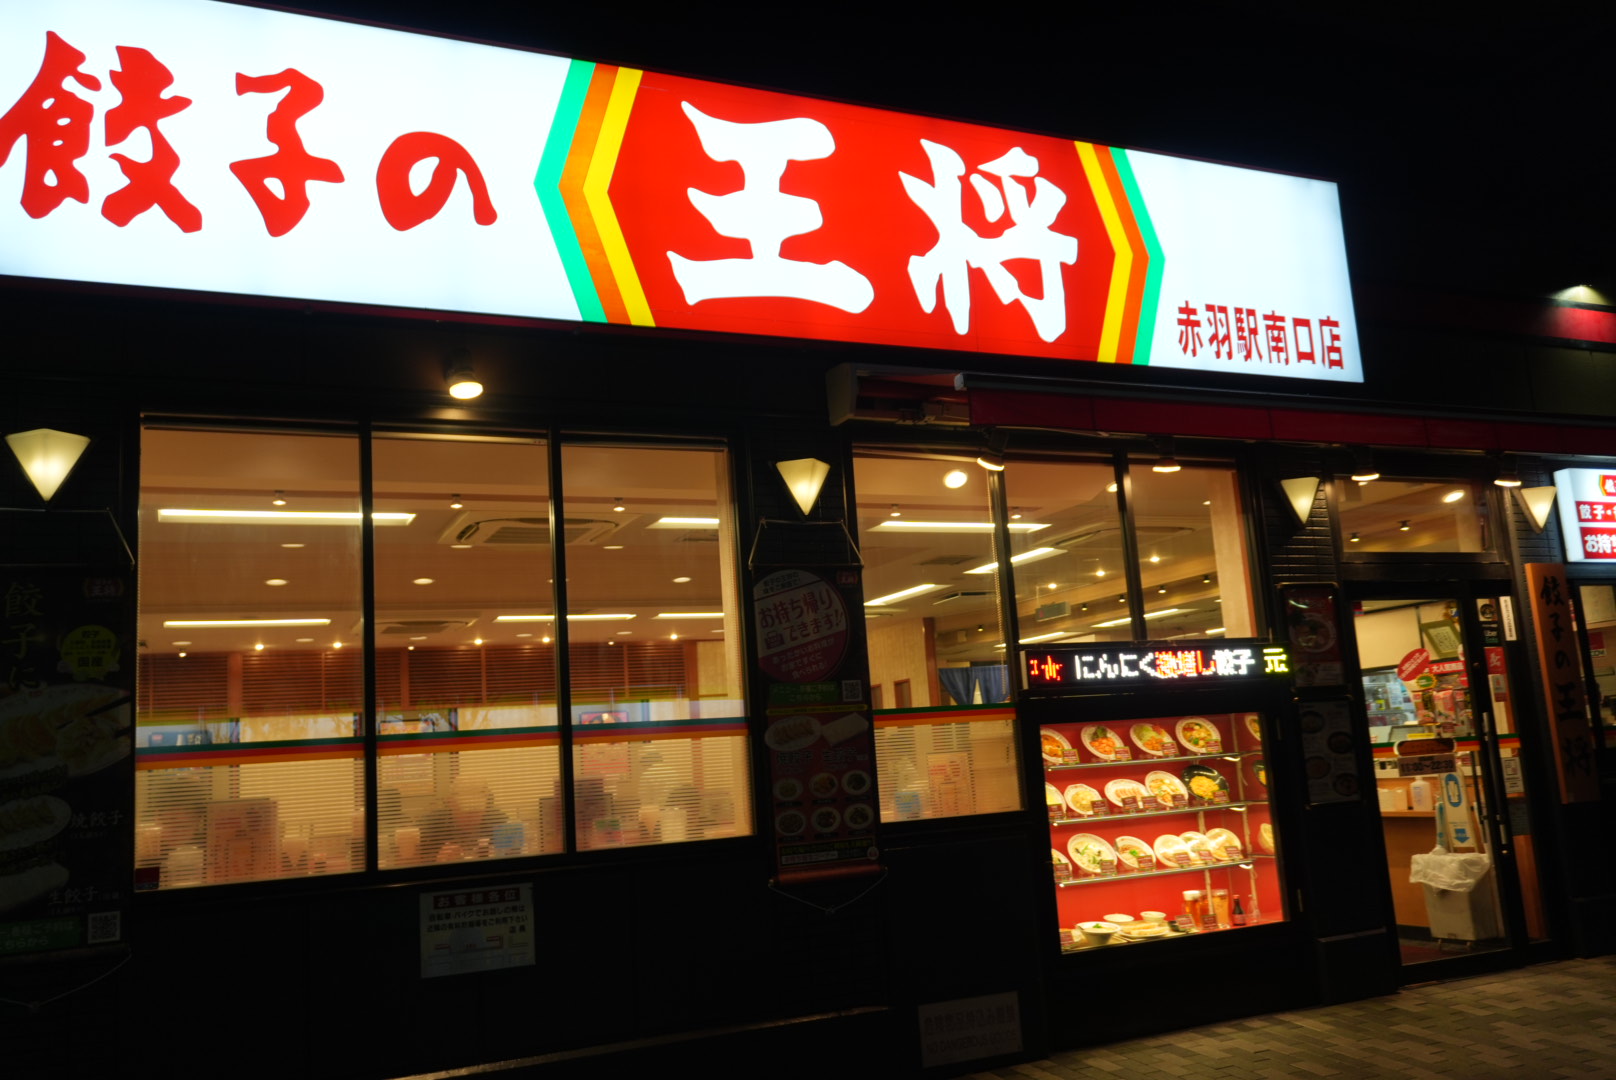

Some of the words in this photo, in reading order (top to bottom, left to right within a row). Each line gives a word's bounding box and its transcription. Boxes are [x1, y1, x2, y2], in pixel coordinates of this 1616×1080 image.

[0, 30, 498, 238] 餃子の
[666, 101, 1079, 343] 王将
[1176, 300, 1345, 370] 赤羽駅南口店
[1579, 504, 1616, 521] 餃子・
[759, 588, 834, 629] お持ち帰り
[1263, 648, 1288, 673] 元
